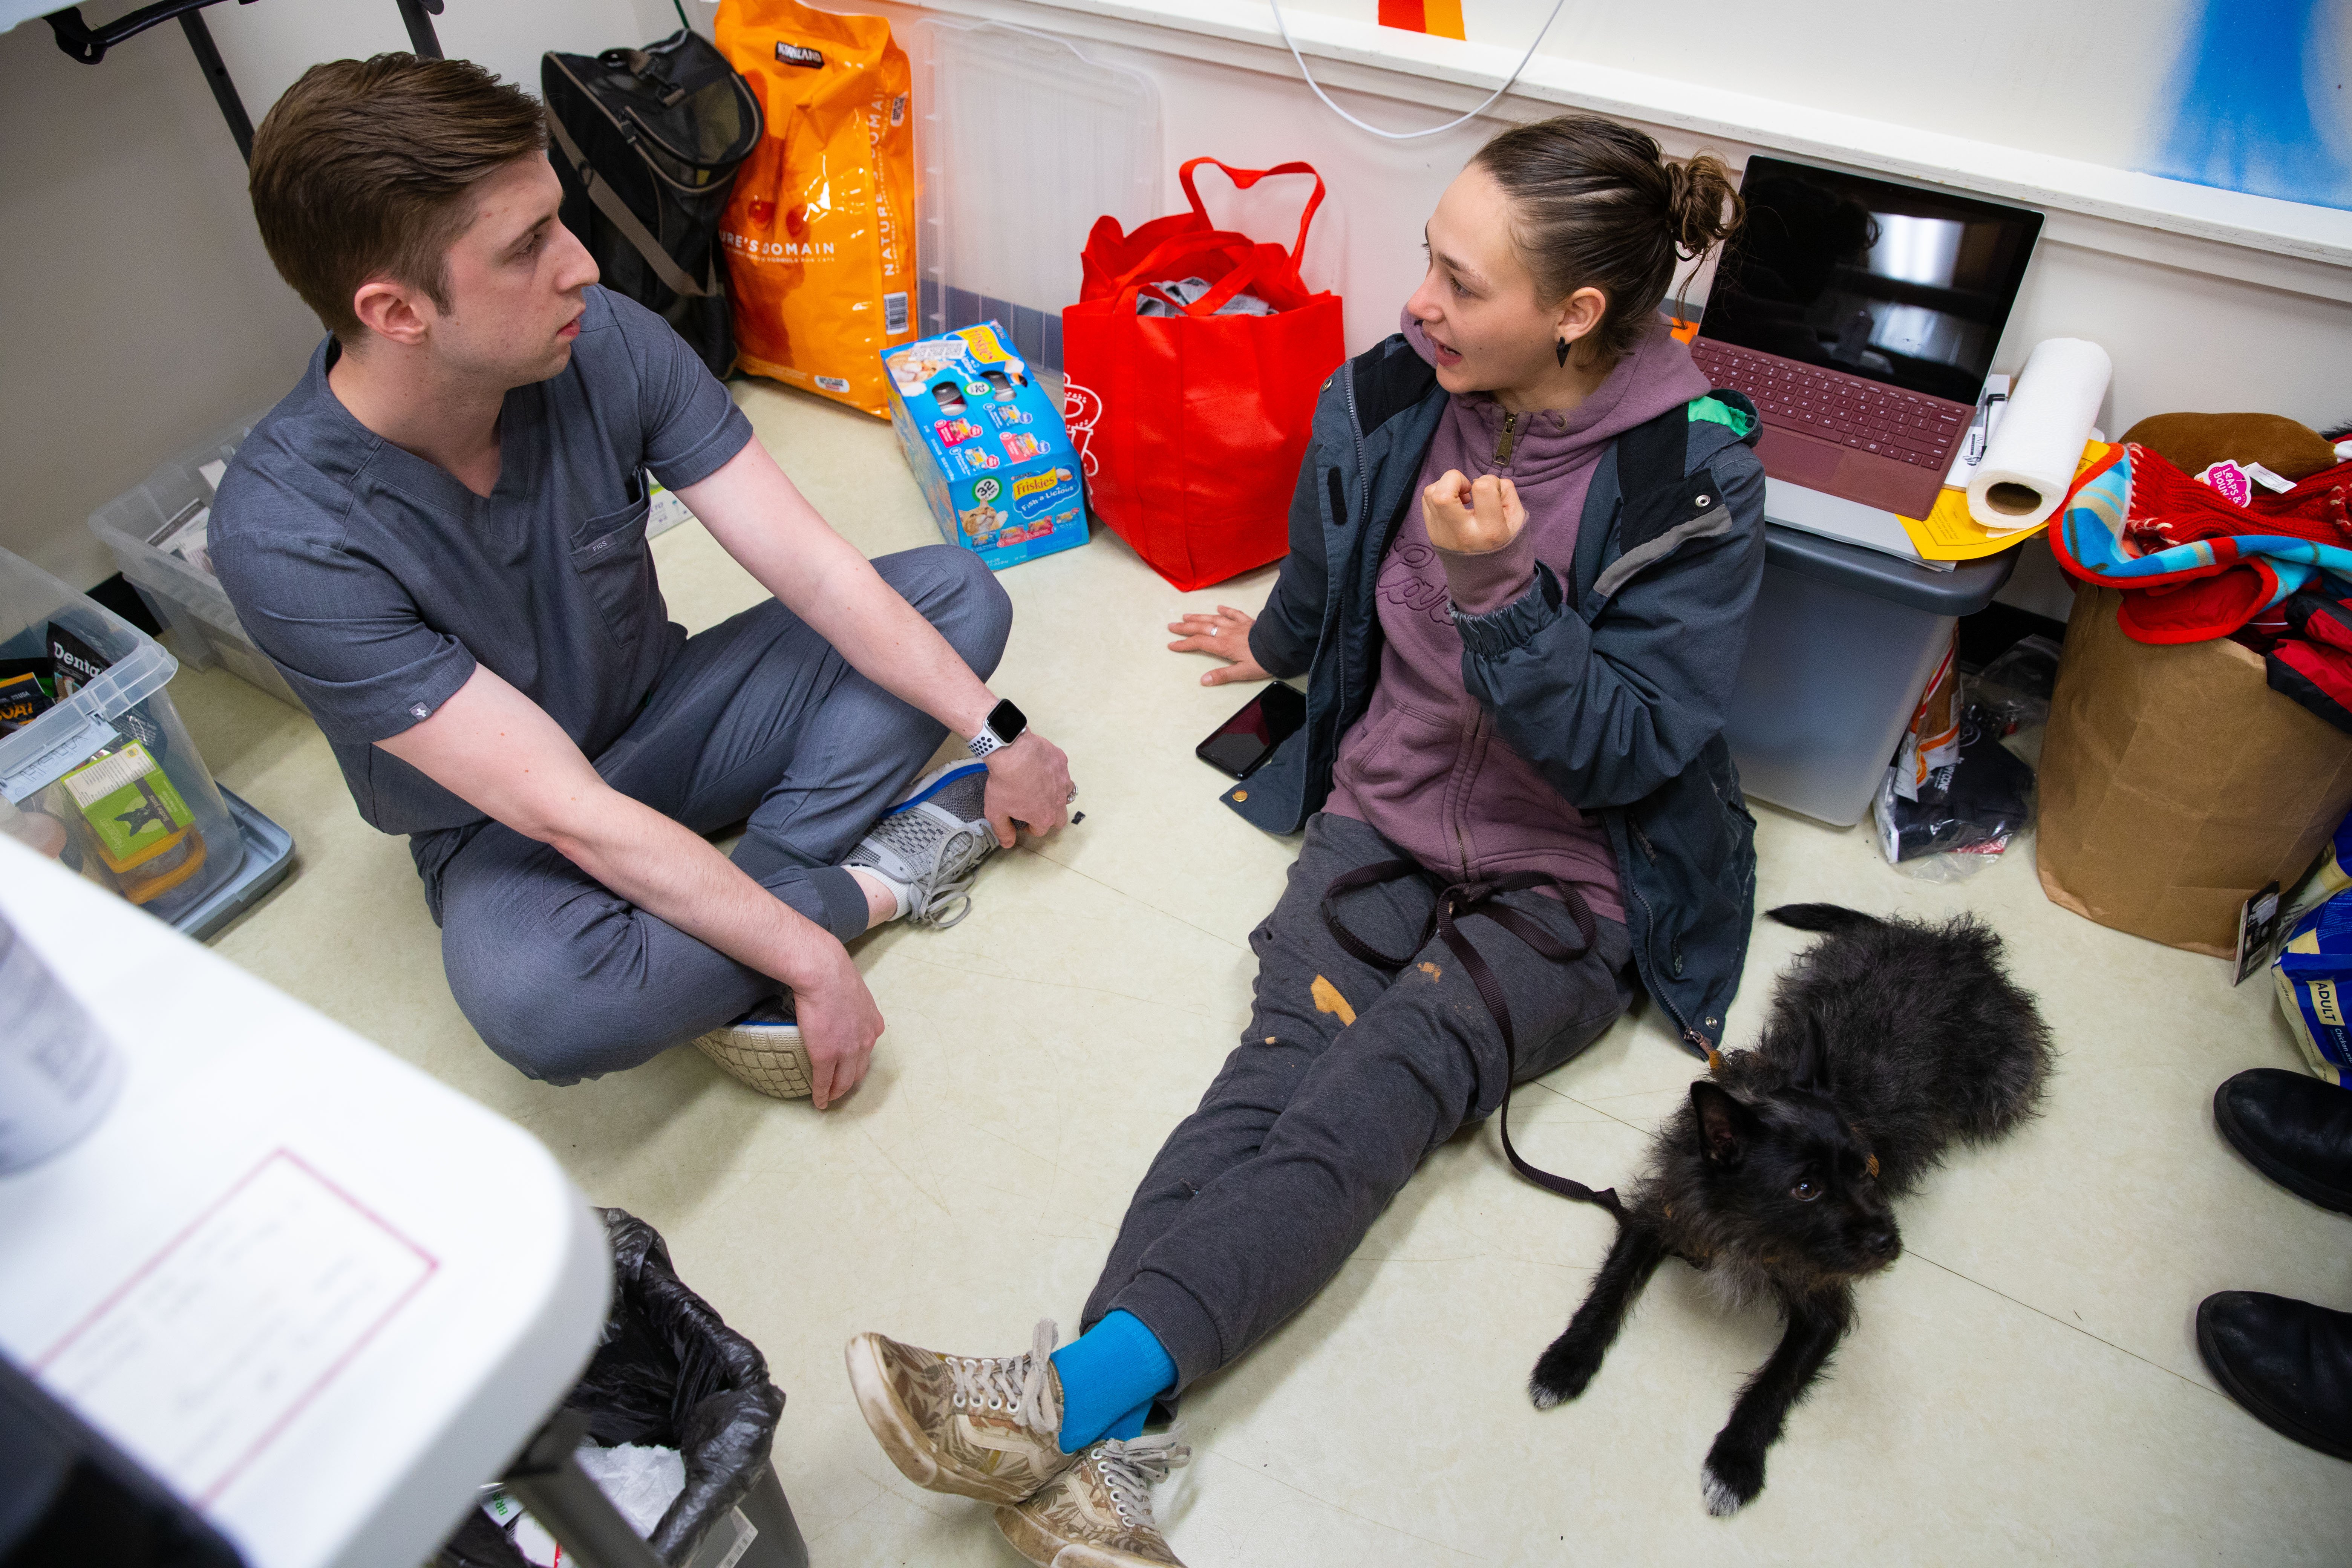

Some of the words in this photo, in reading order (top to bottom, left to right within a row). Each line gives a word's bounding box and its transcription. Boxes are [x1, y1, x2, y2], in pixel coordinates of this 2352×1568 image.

[778, 42, 822, 63] KIRKLAND
[718, 230, 759, 253] URE'S
[762, 242, 835, 256] DOMAIN
[977, 480, 995, 496] 32
[1017, 476, 1055, 495] Friskies
[2213, 471, 2232, 500] BOUN
[593, 541, 607, 552] FIGS
[2315, 983, 2337, 1021] ADULT
[2335, 1028, 2348, 1052] Chicken
